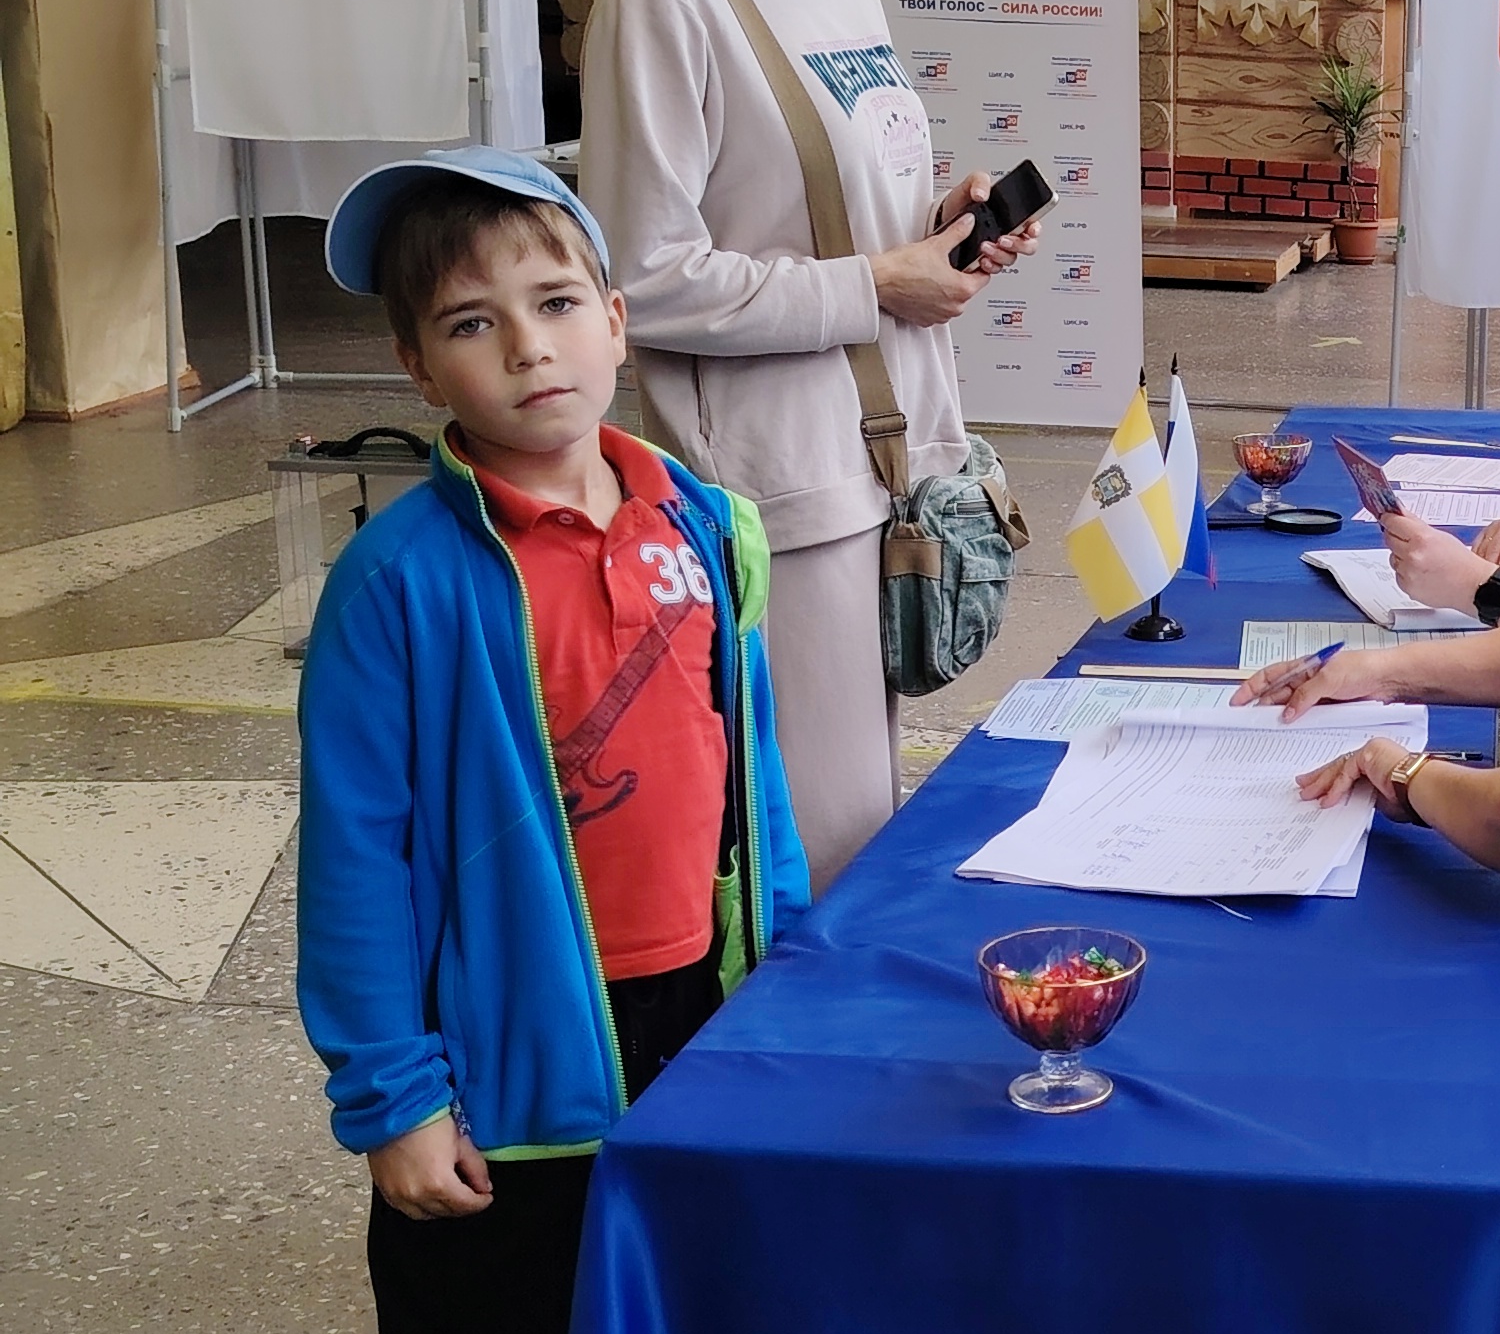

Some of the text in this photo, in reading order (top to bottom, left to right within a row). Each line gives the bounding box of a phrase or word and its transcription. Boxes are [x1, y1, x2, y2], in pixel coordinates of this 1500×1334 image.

[939, 0, 985, 12] ГОЛОС
[1001, 2, 1038, 15] СИЛА
[1042, 4, 1102, 17] РОССИИ!
[639, 542, 714, 604] 36
